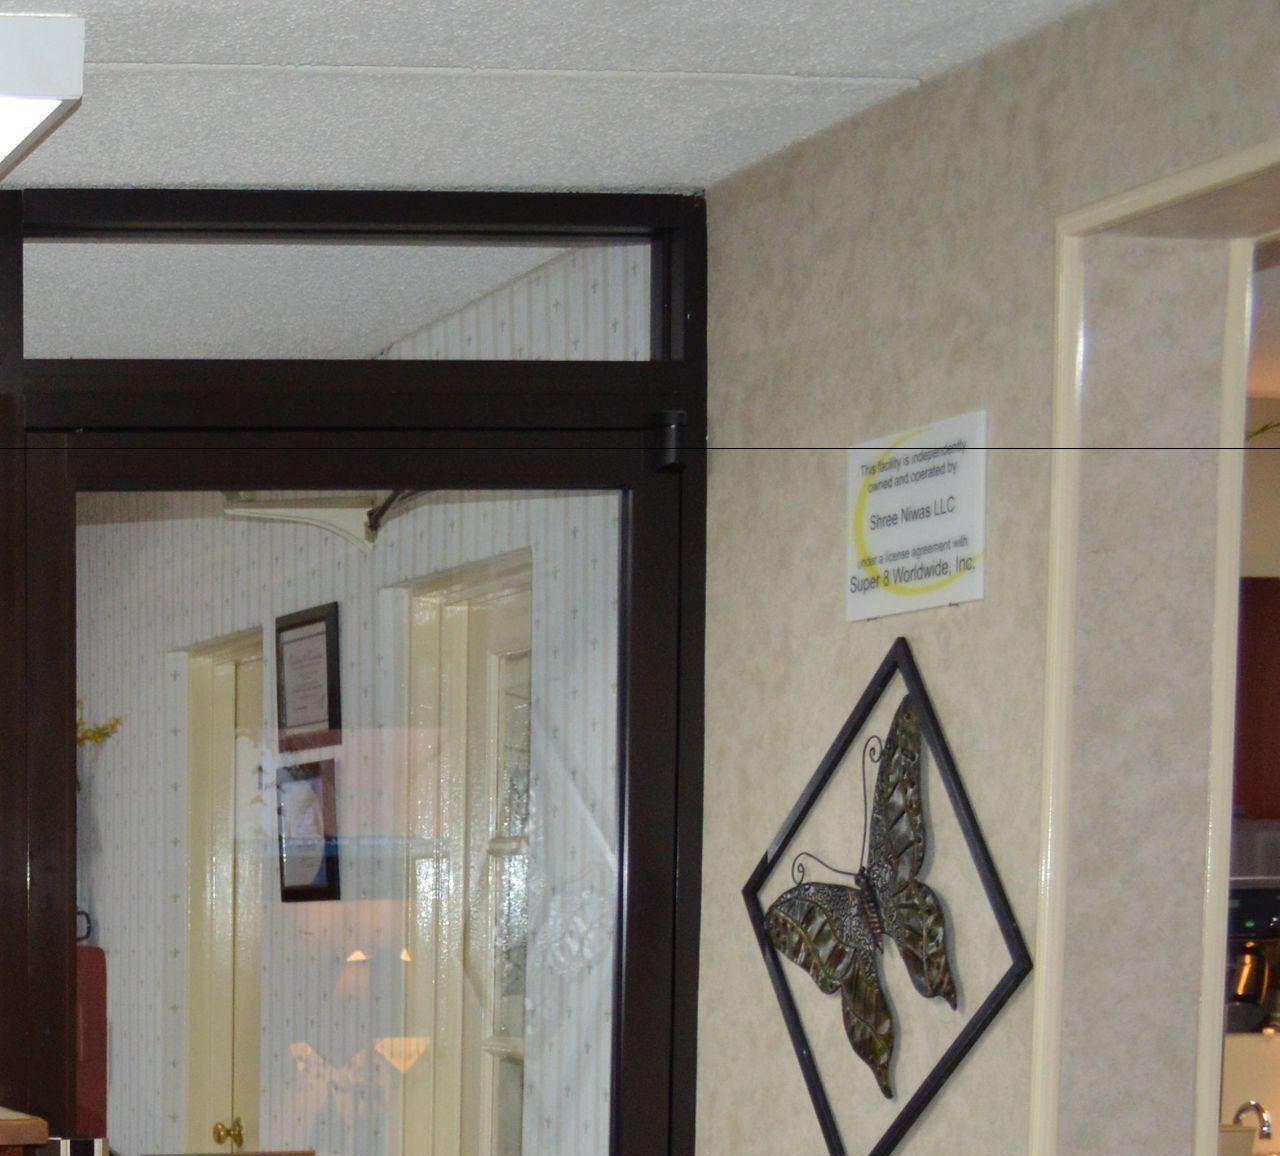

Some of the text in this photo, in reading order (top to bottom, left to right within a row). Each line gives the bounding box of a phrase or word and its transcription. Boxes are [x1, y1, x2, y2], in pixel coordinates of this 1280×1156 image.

[867, 461, 958, 493] owned and operated by
[870, 495, 956, 531] Shree Niwas LLC
[911, 539, 951, 560] agreement
[953, 534, 969, 548] with
[850, 555, 976, 595] Super 8 Worldwide, Inc.
